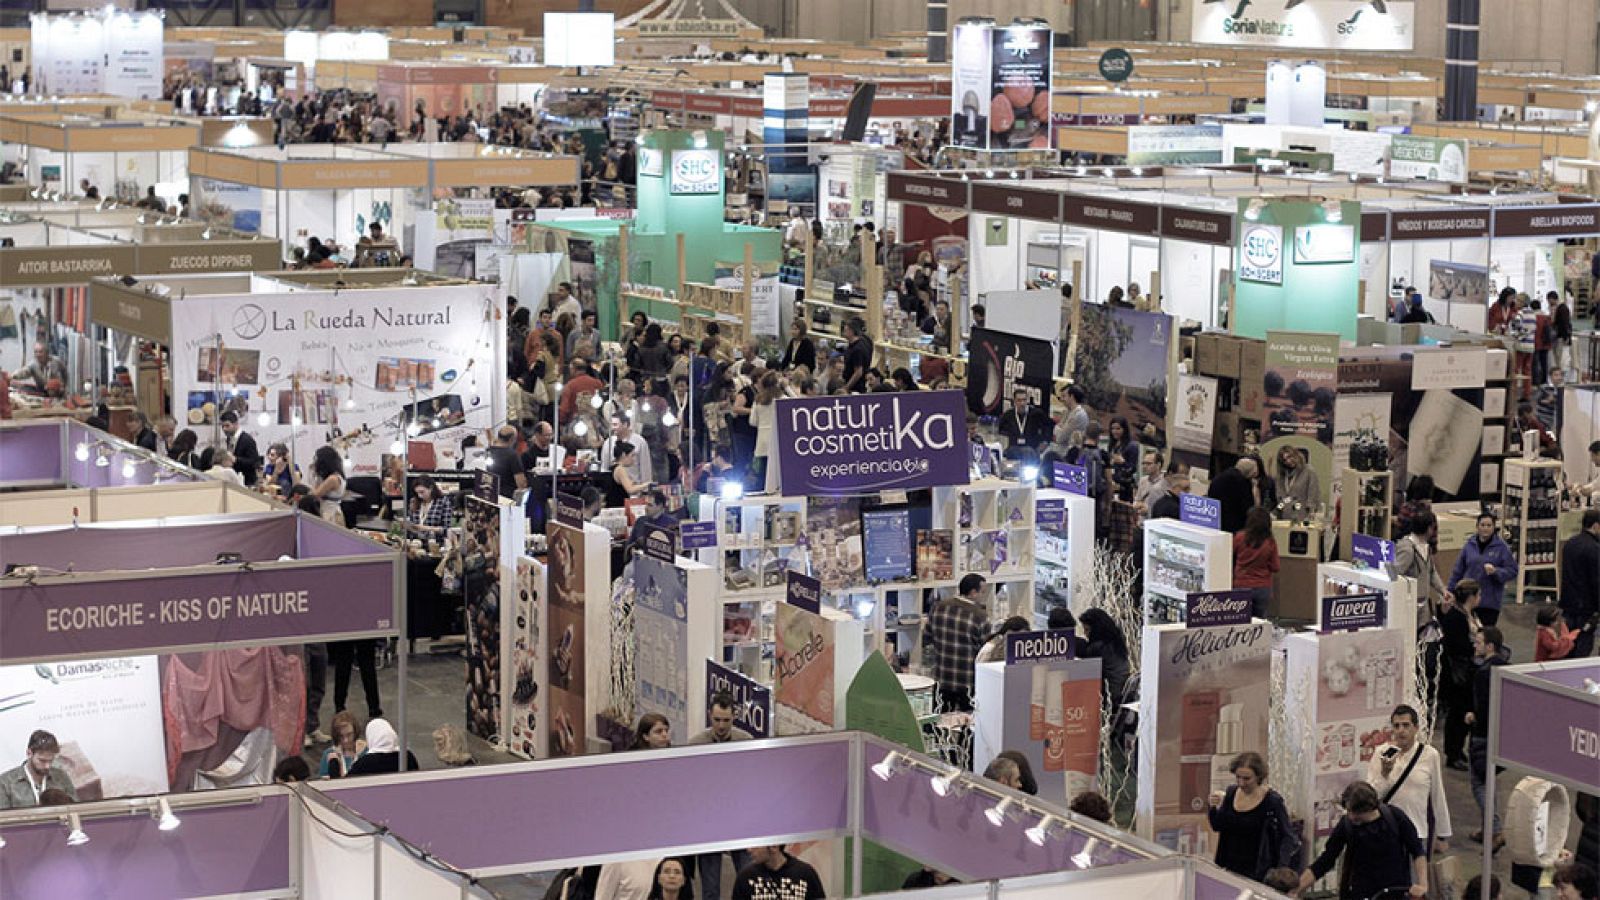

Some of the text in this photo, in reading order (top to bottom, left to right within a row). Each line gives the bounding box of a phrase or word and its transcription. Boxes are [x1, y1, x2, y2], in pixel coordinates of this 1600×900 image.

[680, 159, 711, 175] SHC
[1248, 236, 1275, 259] SHC
[18, 258, 112, 274] AITOR BASTARRIKA
[170, 254, 253, 269] ZUECOS DIPPNER
[272, 305, 450, 331] La Rueda Natural
[791, 399, 880, 432] natur
[47, 603, 144, 632] ECORICHE
[160, 599, 201, 624] KISS
[207, 596, 231, 618] OF
[237, 591, 310, 616] NATURE
[1330, 599, 1376, 617] lavera
[1015, 631, 1068, 658] neobio
[1171, 624, 1264, 665] Heliotrop
